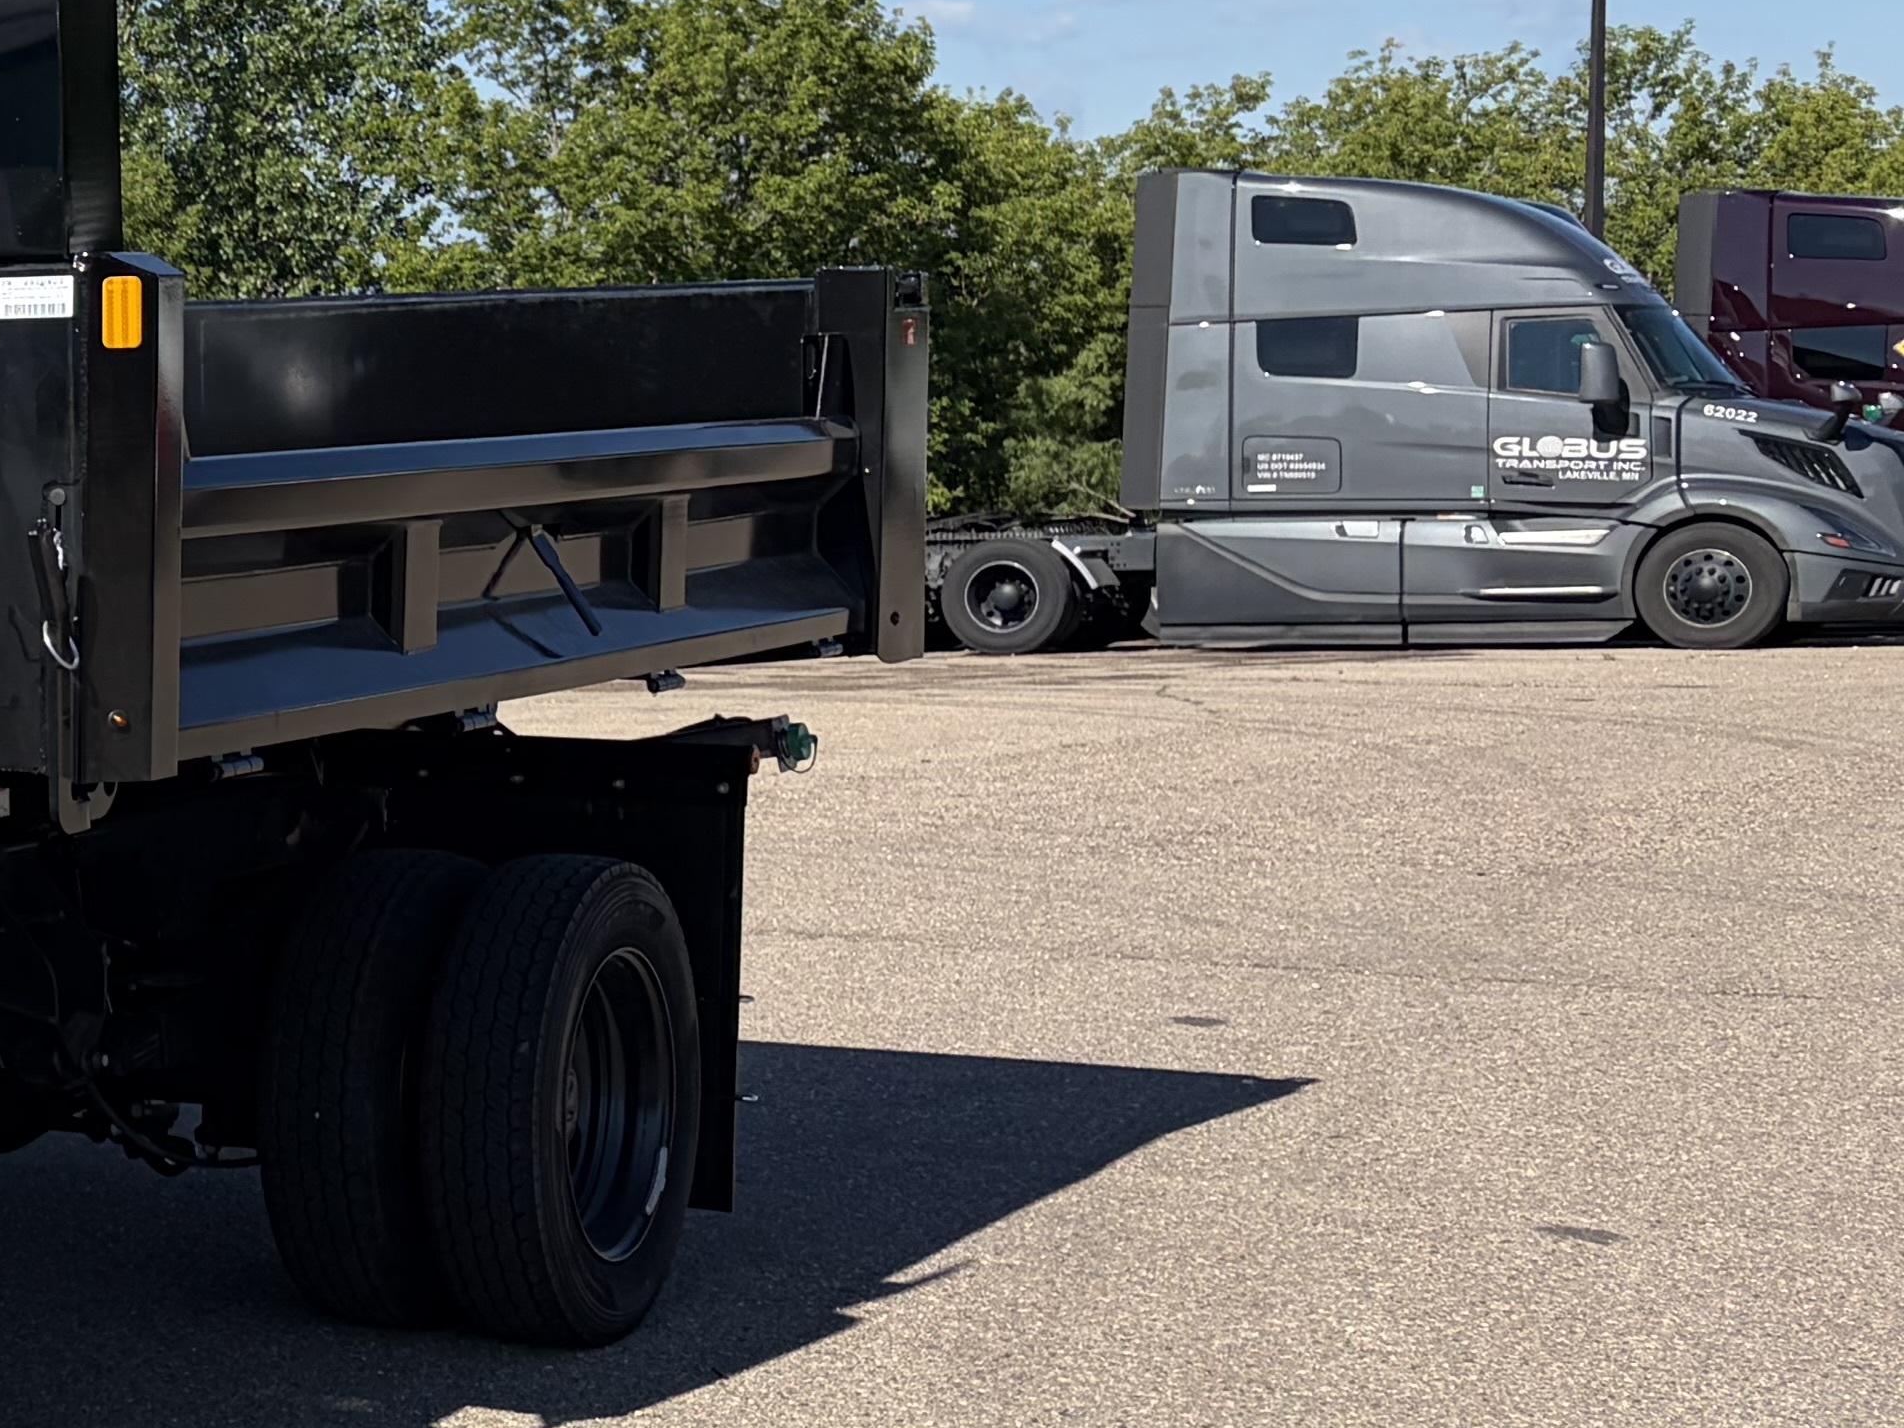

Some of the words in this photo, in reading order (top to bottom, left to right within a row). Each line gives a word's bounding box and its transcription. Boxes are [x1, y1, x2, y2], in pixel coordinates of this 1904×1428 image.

[1703, 404, 1758, 423] 62022
[1493, 435, 1648, 460] GLOBUS
[1495, 458, 1608, 470] TRANSPORT
[1613, 461, 1646, 471] INC.
